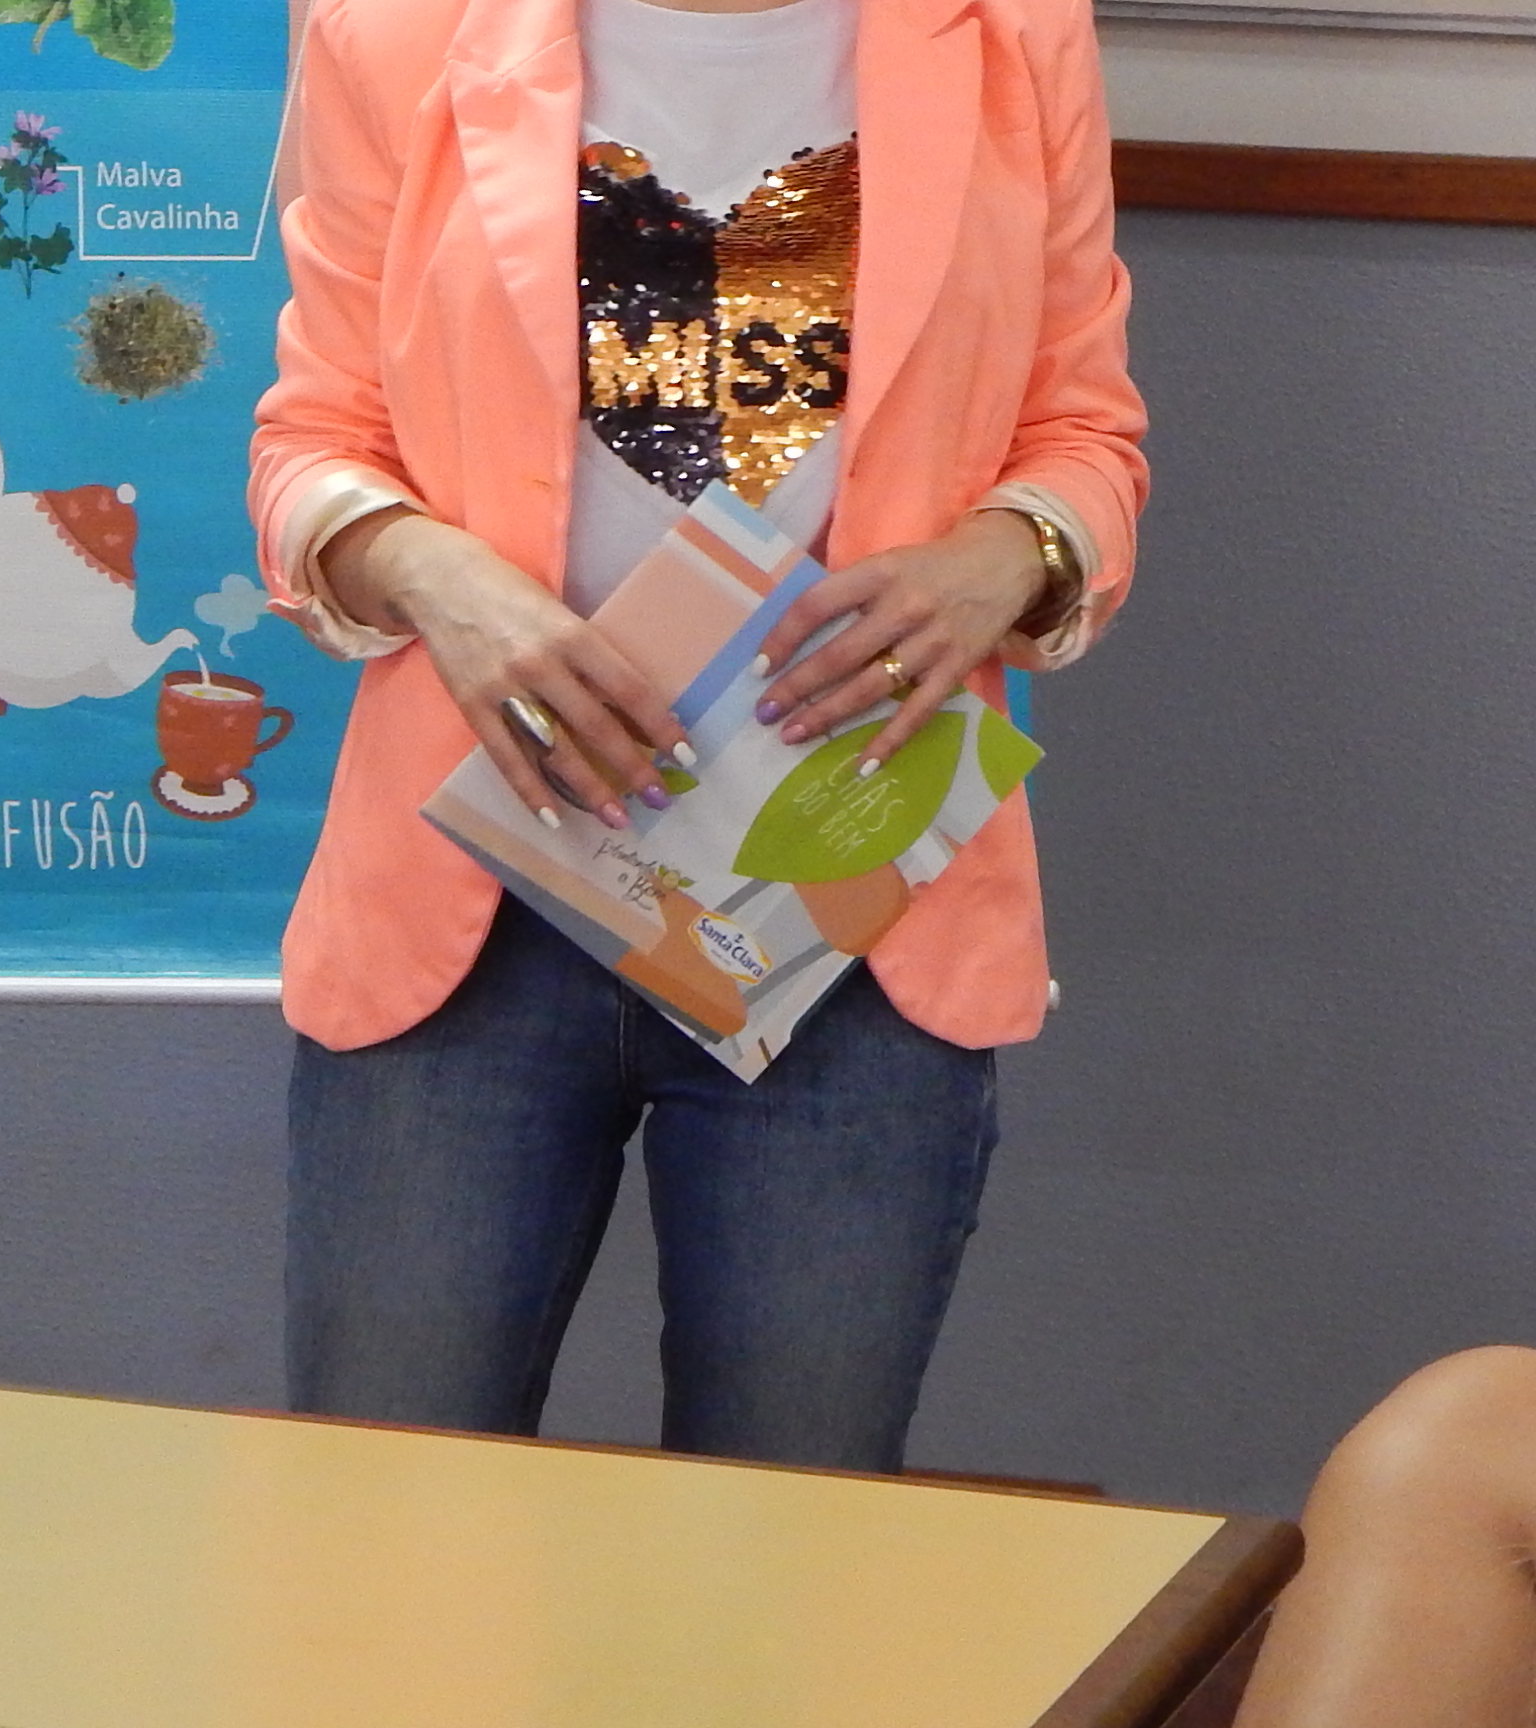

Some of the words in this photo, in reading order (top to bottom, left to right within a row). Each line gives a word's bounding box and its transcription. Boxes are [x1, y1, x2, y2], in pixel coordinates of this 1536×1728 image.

[96, 161, 183, 188] Malva
[96, 202, 240, 232] Cavalinha
[586, 318, 852, 409] MISS
[696, 917, 733, 952] Santa
[730, 946, 764, 978] Clara
